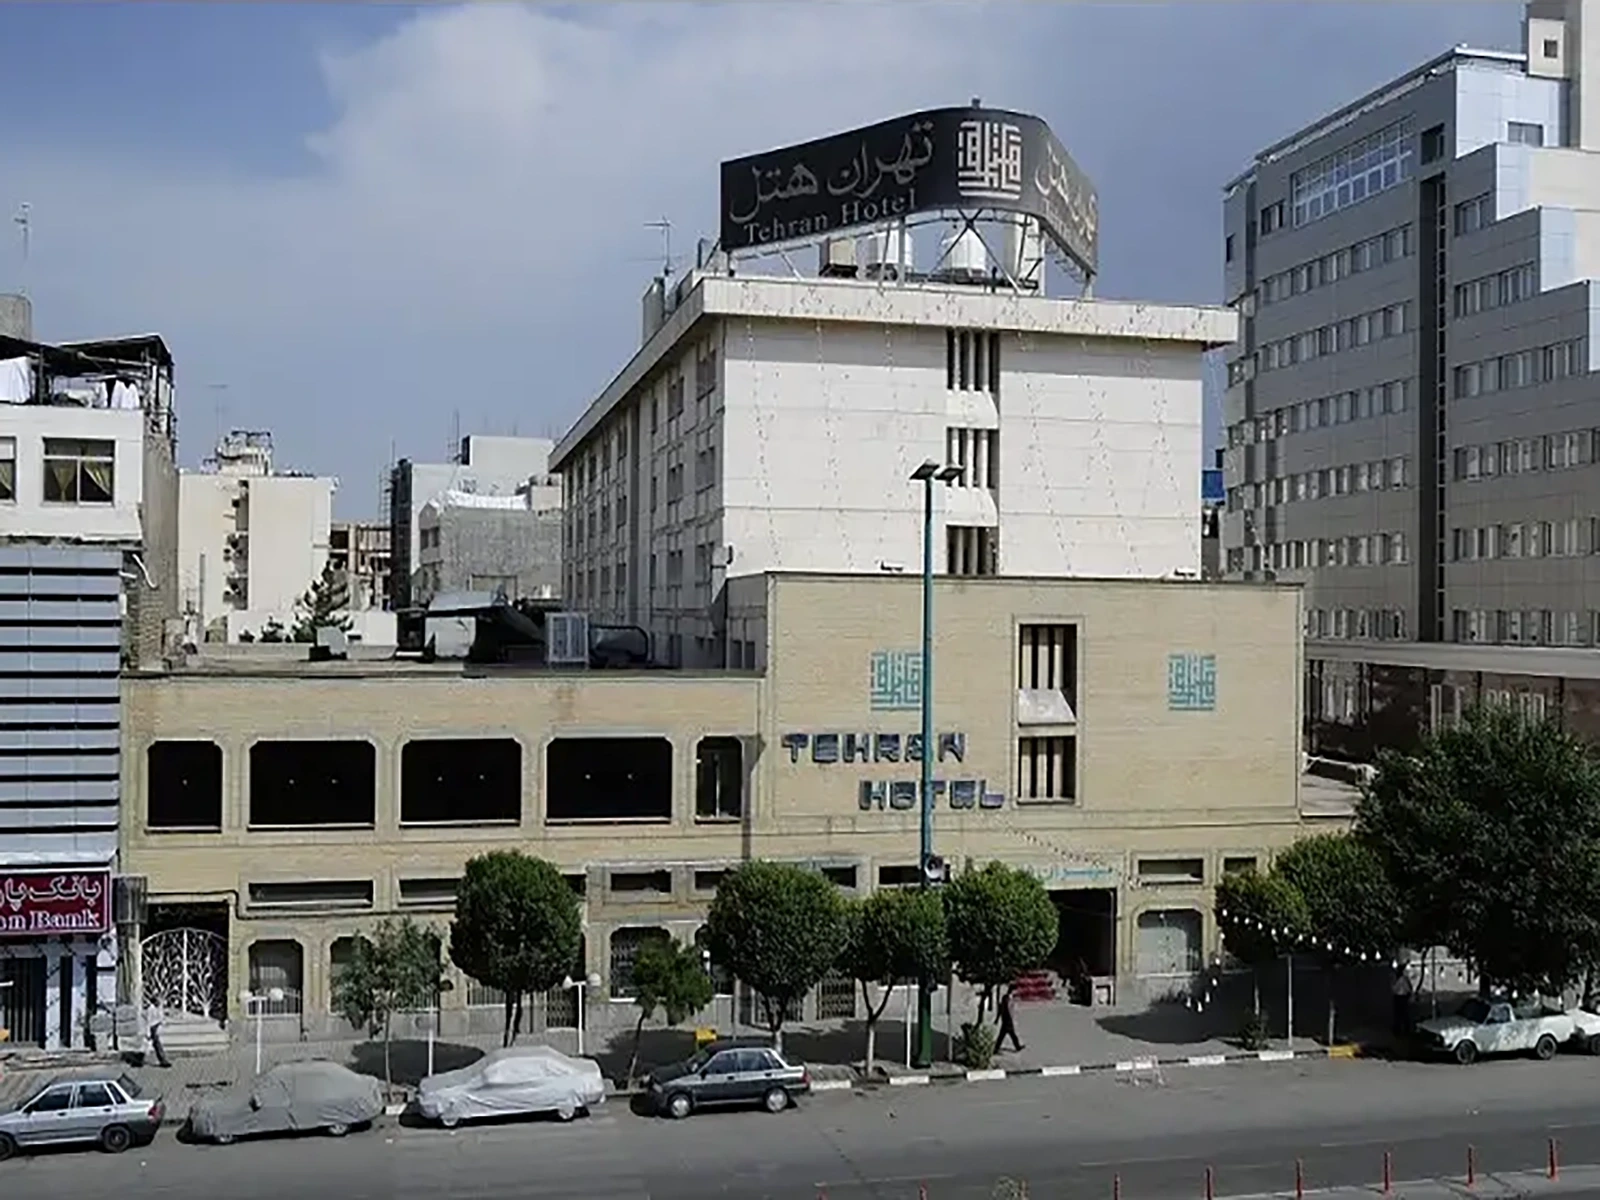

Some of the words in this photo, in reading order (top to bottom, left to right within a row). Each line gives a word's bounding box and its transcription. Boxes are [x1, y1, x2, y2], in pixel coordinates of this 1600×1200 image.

[825, 119, 934, 200] تهران
[729, 163, 819, 224] هتل
[743, 210, 828, 244] Tehran
[840, 187, 916, 224] Hotel
[781, 733, 966, 763] TEHRAN
[29, 875, 102, 908] بانک
[28, 908, 101, 931] Bank
